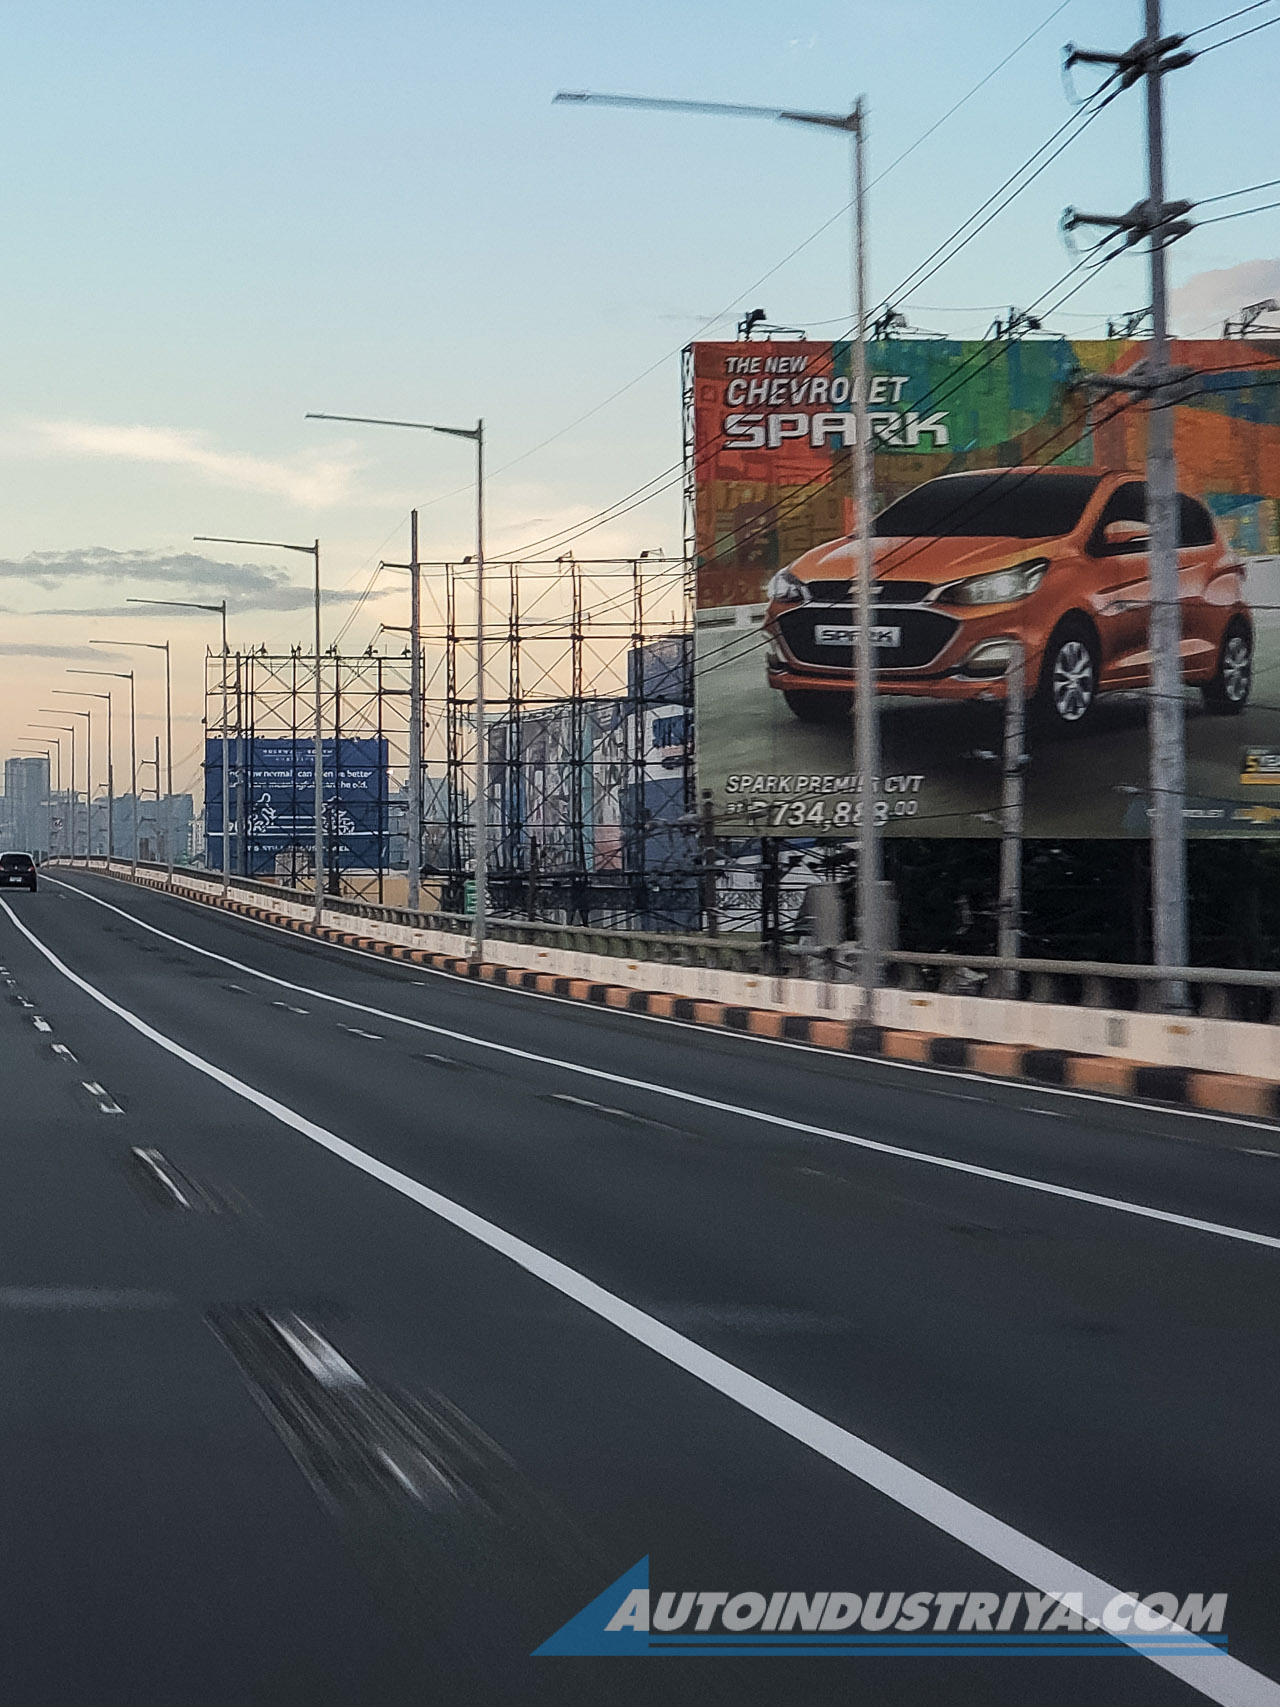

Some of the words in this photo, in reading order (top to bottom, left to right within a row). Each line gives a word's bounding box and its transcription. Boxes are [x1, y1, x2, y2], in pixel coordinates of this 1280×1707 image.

[726, 356, 762, 374] THE
[765, 356, 808, 373] NEW
[724, 411, 950, 449] SPARK
[297, 770, 313, 778] can
[726, 775, 794, 794] SPARK
[795, 775, 880, 793] PREMI
[884, 775, 925, 793] CVT
